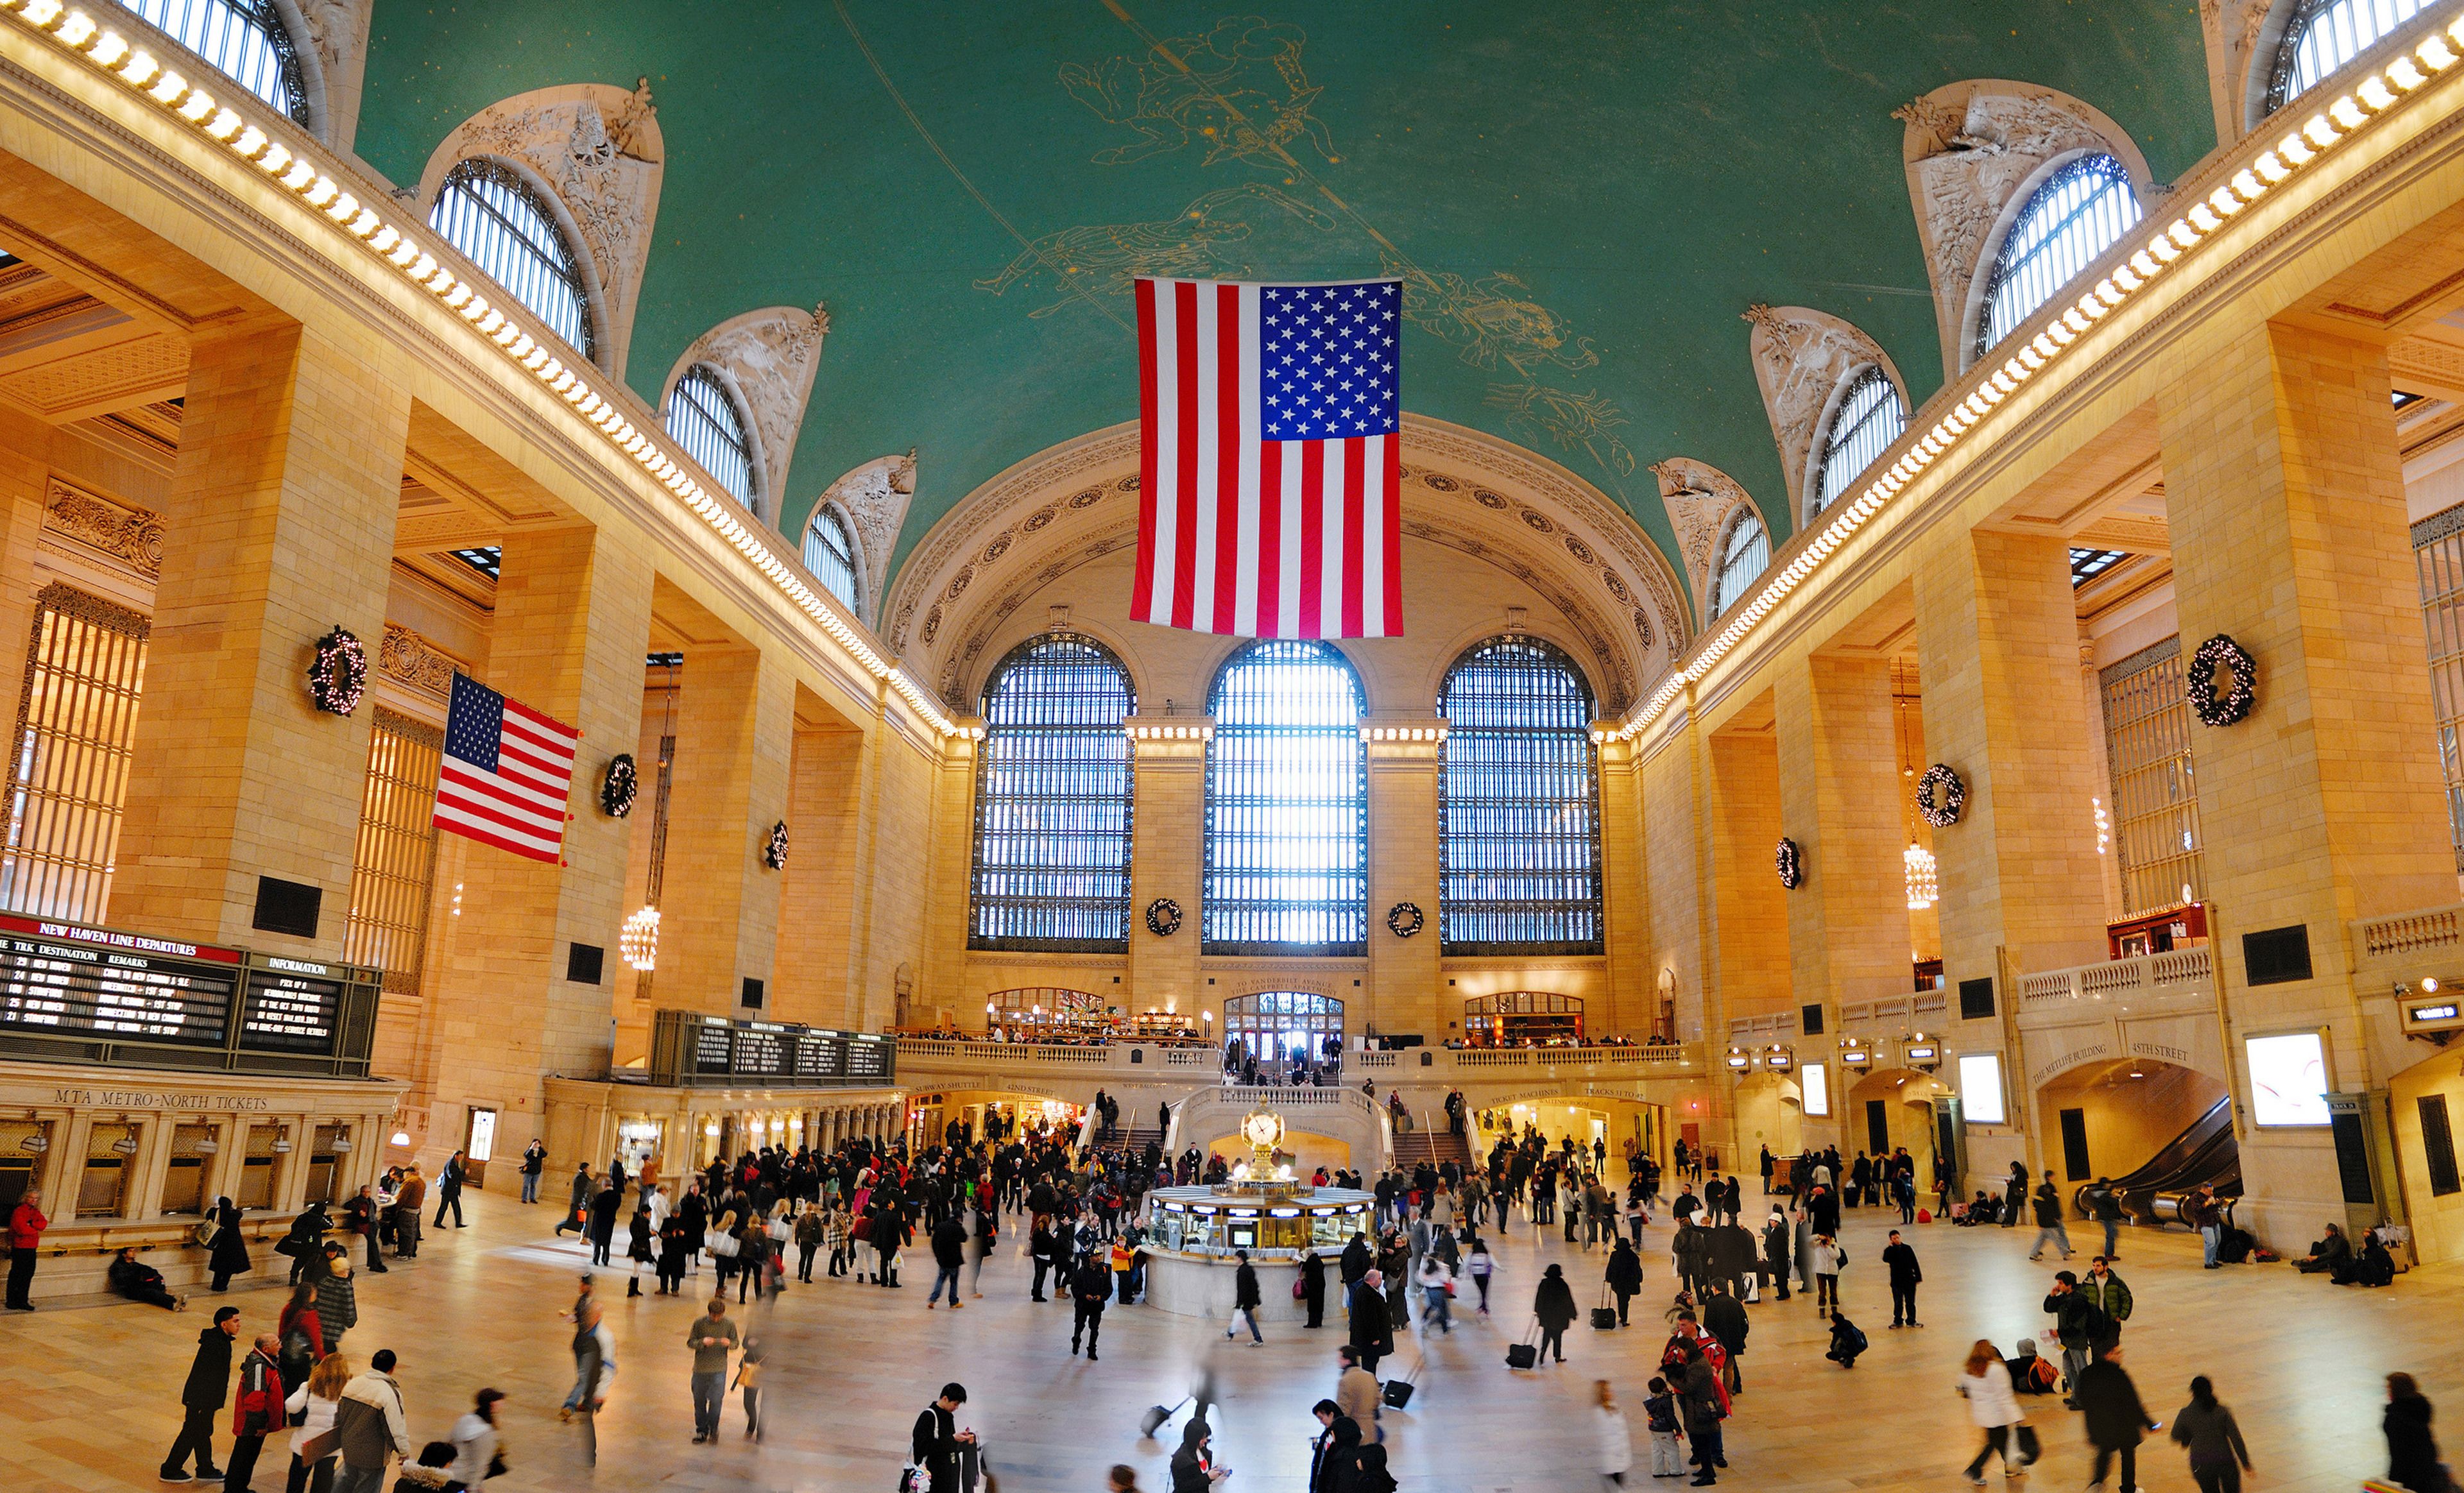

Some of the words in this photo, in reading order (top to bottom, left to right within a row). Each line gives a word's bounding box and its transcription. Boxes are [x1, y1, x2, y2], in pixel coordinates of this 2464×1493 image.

[39, 923, 69, 937] NEW
[69, 927, 108, 943] HAVEN
[109, 933, 135, 948] LINE
[135, 937, 196, 956] DEPARTURES
[14, 941, 35, 953] TRK
[38, 945, 98, 961] DESTINATION
[108, 955, 148, 968] REMARKS
[269, 957, 327, 975] INFORMATION
[1302, 978, 1331, 988] AVENUE
[246, 1021, 258, 1030] FOR
[2132, 1043, 2153, 1055] 45TH
[2155, 1045, 2188, 1061] STREET
[2033, 1068, 2047, 1084] THE
[2045, 1054, 2073, 1073] METLIFE
[2073, 1044, 2107, 1061] BUILDING
[914, 1083, 946, 1093] SUBWAY
[1027, 1086, 1056, 1096] STREET
[1491, 1094, 1518, 1104] TICKET
[1519, 1089, 1559, 1100] MACHINES
[55, 1089, 91, 1104] MTA
[100, 1091, 209, 1109] METRO-NORTH
[216, 1095, 267, 1110] TICKETS
